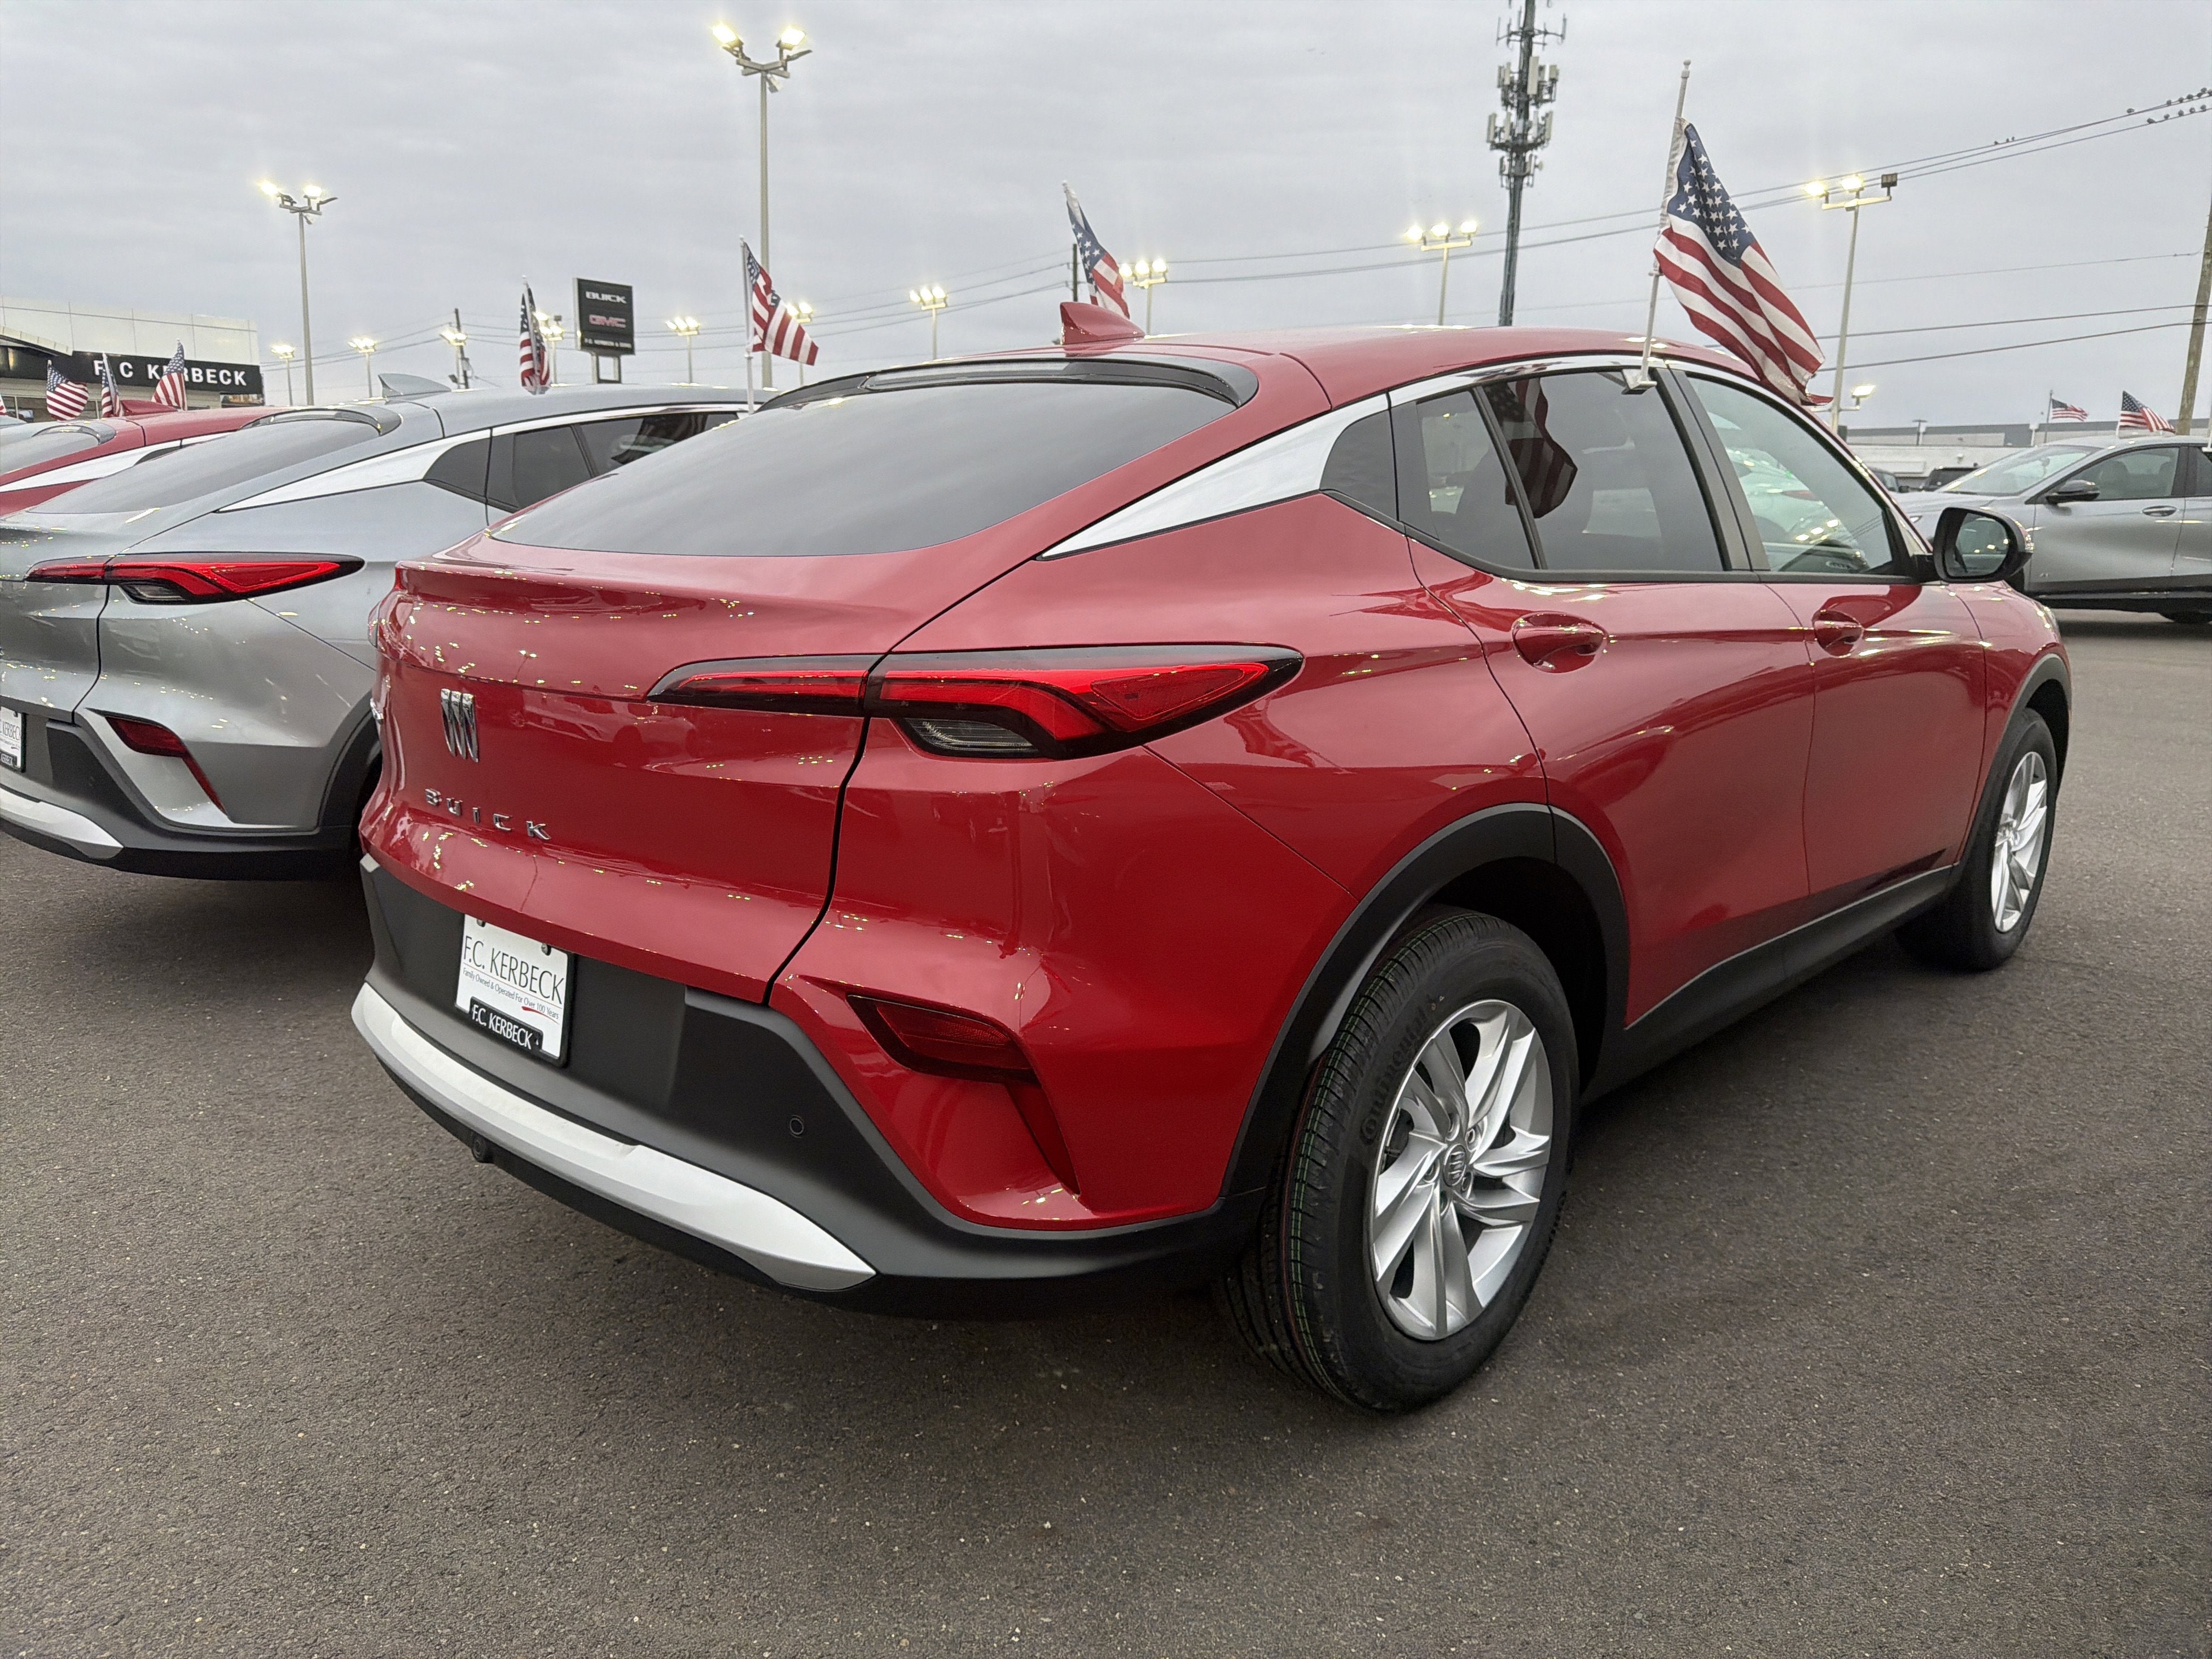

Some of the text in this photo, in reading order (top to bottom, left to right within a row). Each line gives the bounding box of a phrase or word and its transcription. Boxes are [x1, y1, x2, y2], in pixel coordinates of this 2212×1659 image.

[585, 291, 627, 303] BUICK
[589, 314, 626, 328] GMC
[425, 788, 551, 840] BUICK
[464, 935, 564, 1005] F.C. KERBECK
[463, 967, 475, 981] Family
[475, 974, 490, 988] Owned
[495, 984, 515, 1000] Operated
[515, 992, 523, 1003] For
[524, 997, 535, 1008] Over
[537, 1003, 545, 1013] 100
[547, 1007, 559, 1020] Years
[488, 1013, 532, 1049] KERBECK
